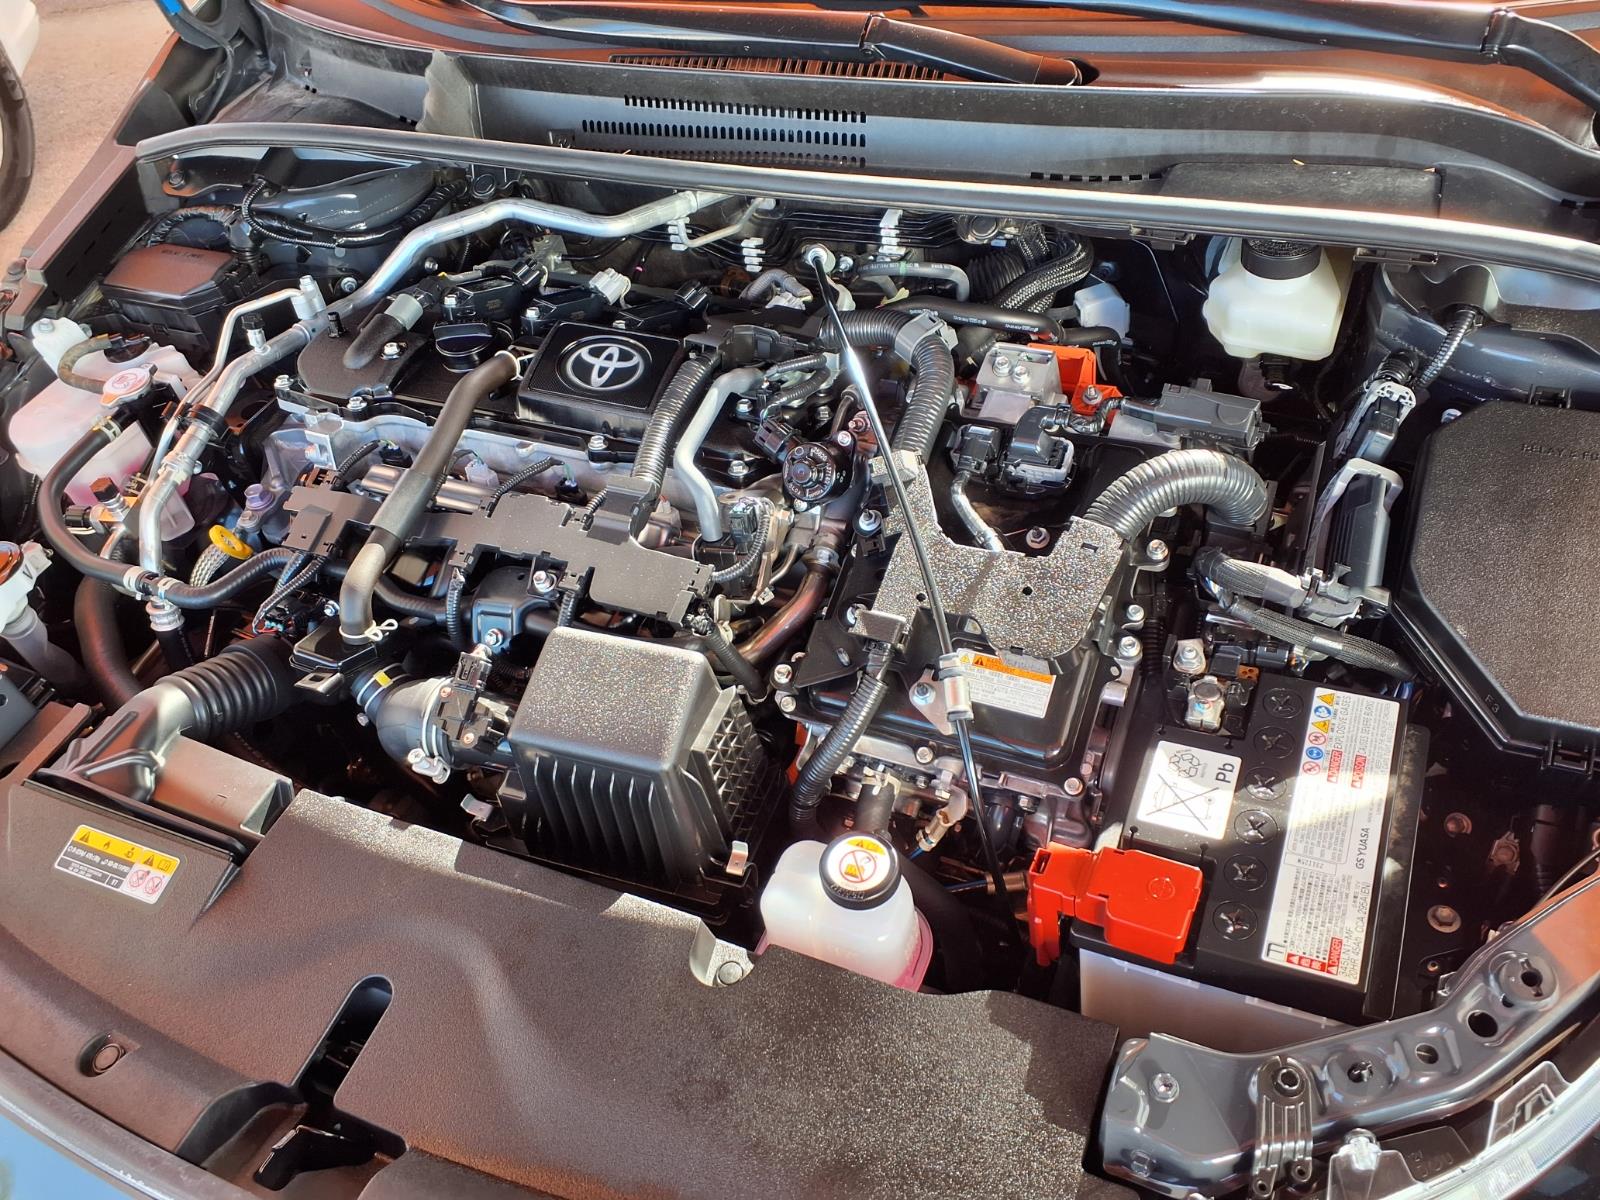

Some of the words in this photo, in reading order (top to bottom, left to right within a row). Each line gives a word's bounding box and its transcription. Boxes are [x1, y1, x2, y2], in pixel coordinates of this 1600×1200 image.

[1339, 695, 1351, 715] GASES
[1333, 717, 1347, 749] EXPLOSIVE
[1216, 762, 1235, 784] Pb
[1328, 750, 1341, 776] DANGER
[1352, 755, 1366, 781] POISON
[1357, 826, 1370, 857] YUASA
[1355, 856, 1365, 870] GS
[1356, 881, 1371, 914] 295A(EN)
[1354, 915, 1365, 933] CCA
[1328, 937, 1341, 965] DANGER
[1350, 935, 1362, 956] 45Ah
[1346, 957, 1359, 979] 20HR
